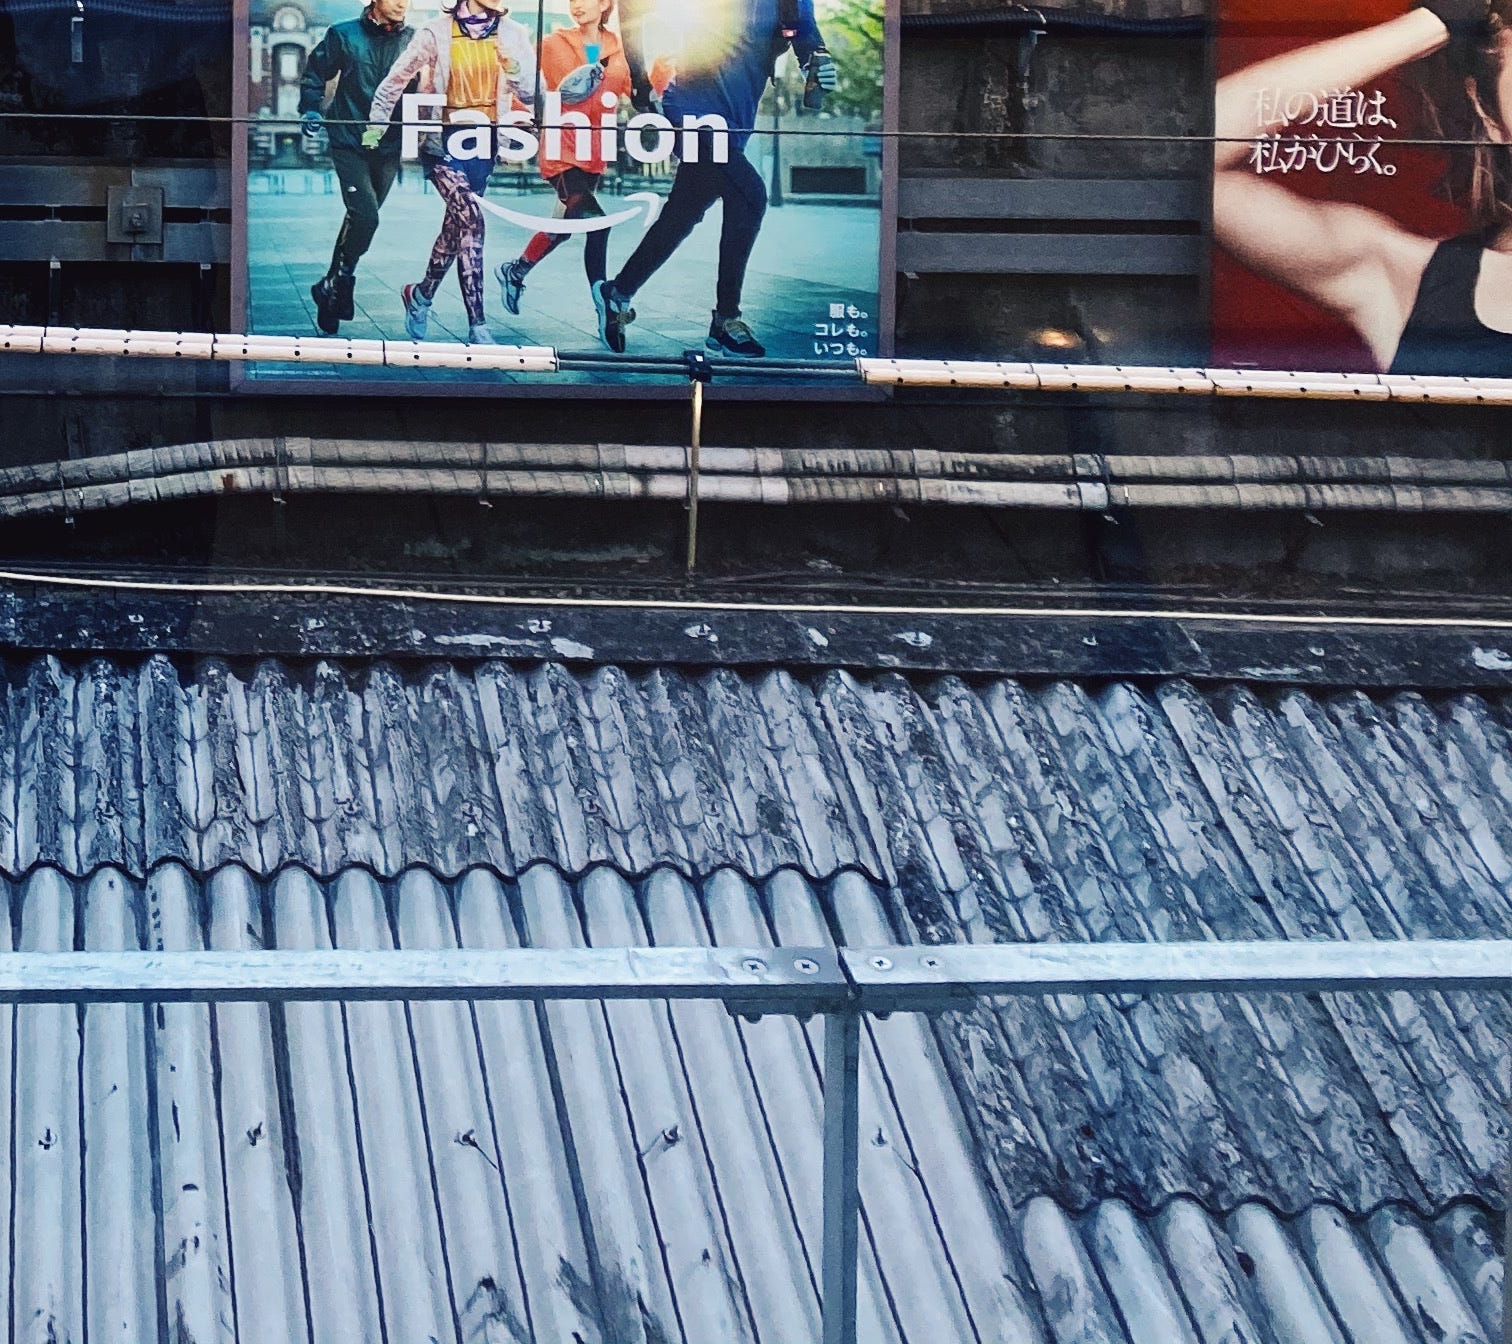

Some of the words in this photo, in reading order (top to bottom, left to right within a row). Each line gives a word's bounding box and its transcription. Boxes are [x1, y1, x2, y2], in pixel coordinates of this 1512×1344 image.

[401, 90, 729, 164] Fashion
[814, 323, 868, 338] コレも。
[813, 342, 868, 356] いつも。
